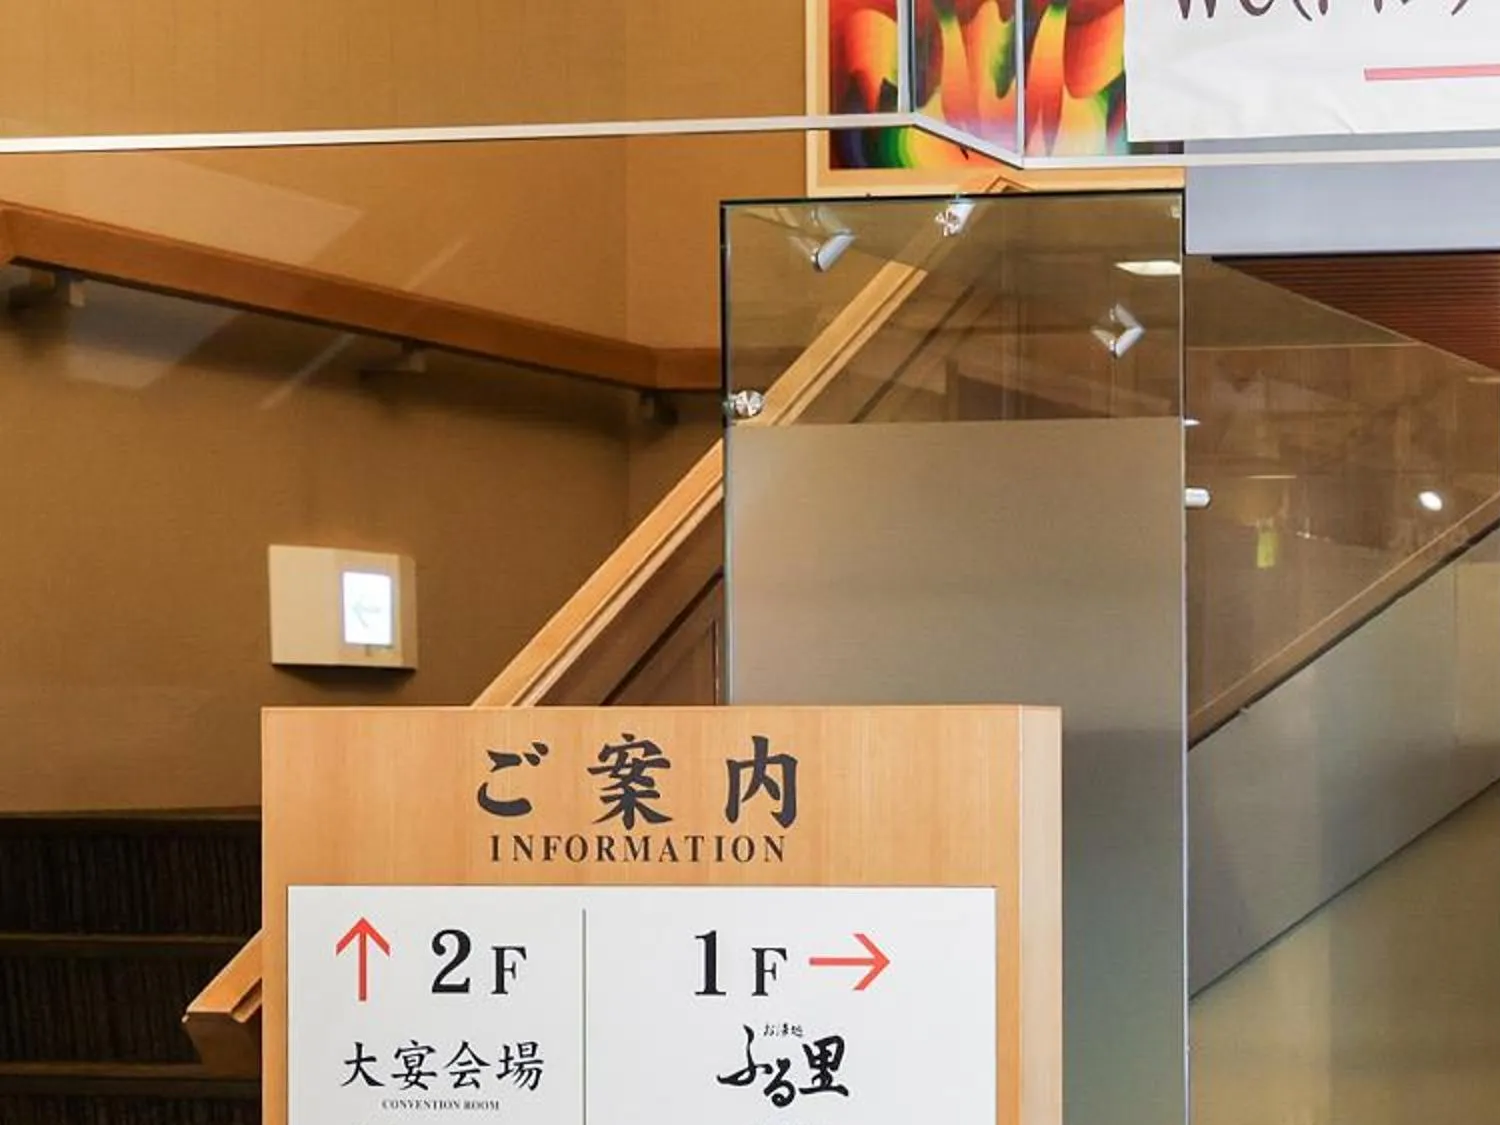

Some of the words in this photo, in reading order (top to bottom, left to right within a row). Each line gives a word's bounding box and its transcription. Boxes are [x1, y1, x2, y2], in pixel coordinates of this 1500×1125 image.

[476, 732, 798, 829] ご案内
[490, 833, 785, 864] INFORMATION
[431, 928, 527, 995] 2F
[694, 929, 788, 997] 1F
[341, 1039, 545, 1092] 大宴会場
[716, 1024, 849, 1108] ふる里
[381, 1099, 460, 1111] CONVENTION
[463, 1100, 500, 1111] ROOM
